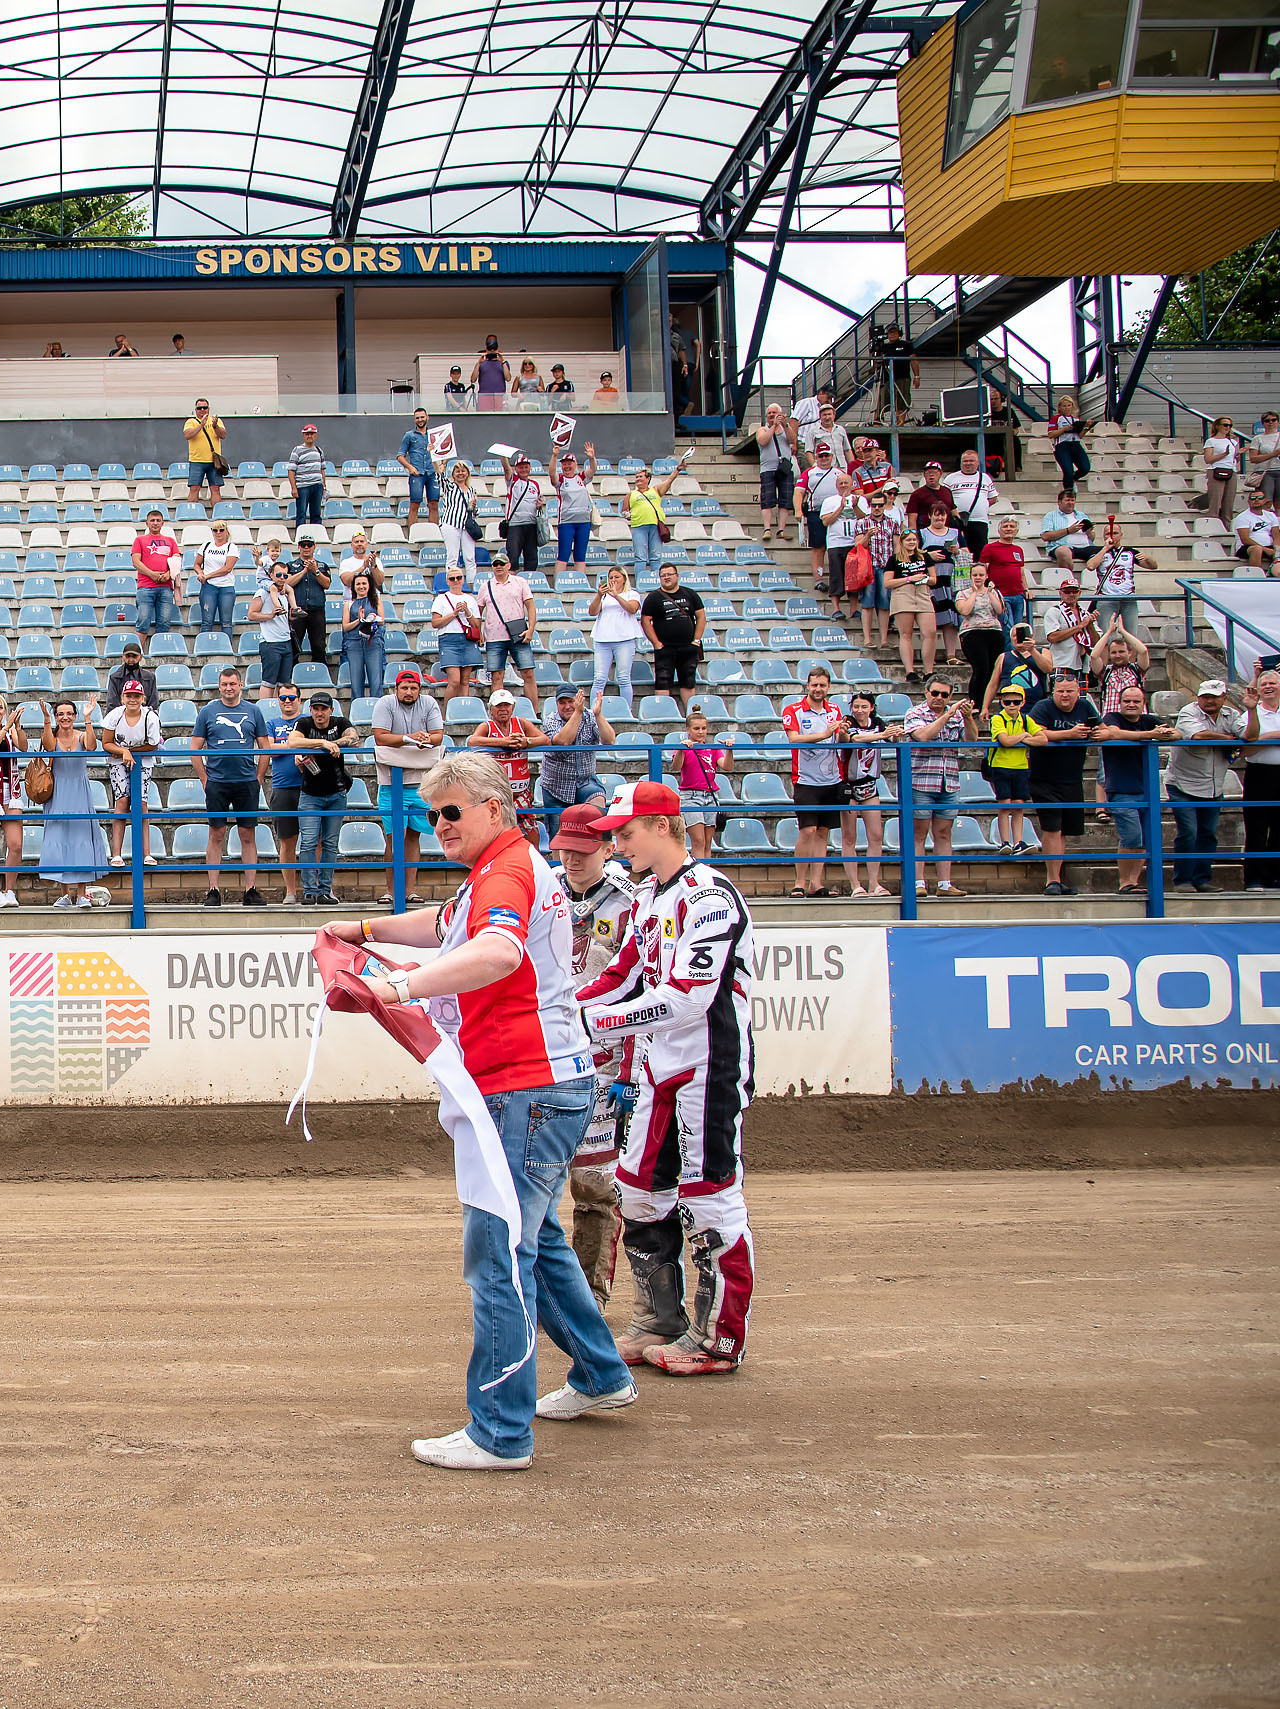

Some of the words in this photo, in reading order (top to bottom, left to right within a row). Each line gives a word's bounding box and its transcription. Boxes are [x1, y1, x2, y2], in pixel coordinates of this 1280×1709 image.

[196, 246, 402, 273] SPONSORS
[414, 246, 498, 272] V.I.P.
[688, 971, 712, 979] Systems
[753, 946, 844, 980] VPILS
[168, 1004, 195, 1040] IR
[208, 1003, 322, 1039] SPORTS
[596, 1004, 668, 1029] MOTOSPORTS
[753, 996, 830, 1032] DWAY
[1076, 1044, 1132, 1066] CAR
[1136, 1044, 1217, 1065] PARTS
[1225, 1042, 1279, 1063] ONL
